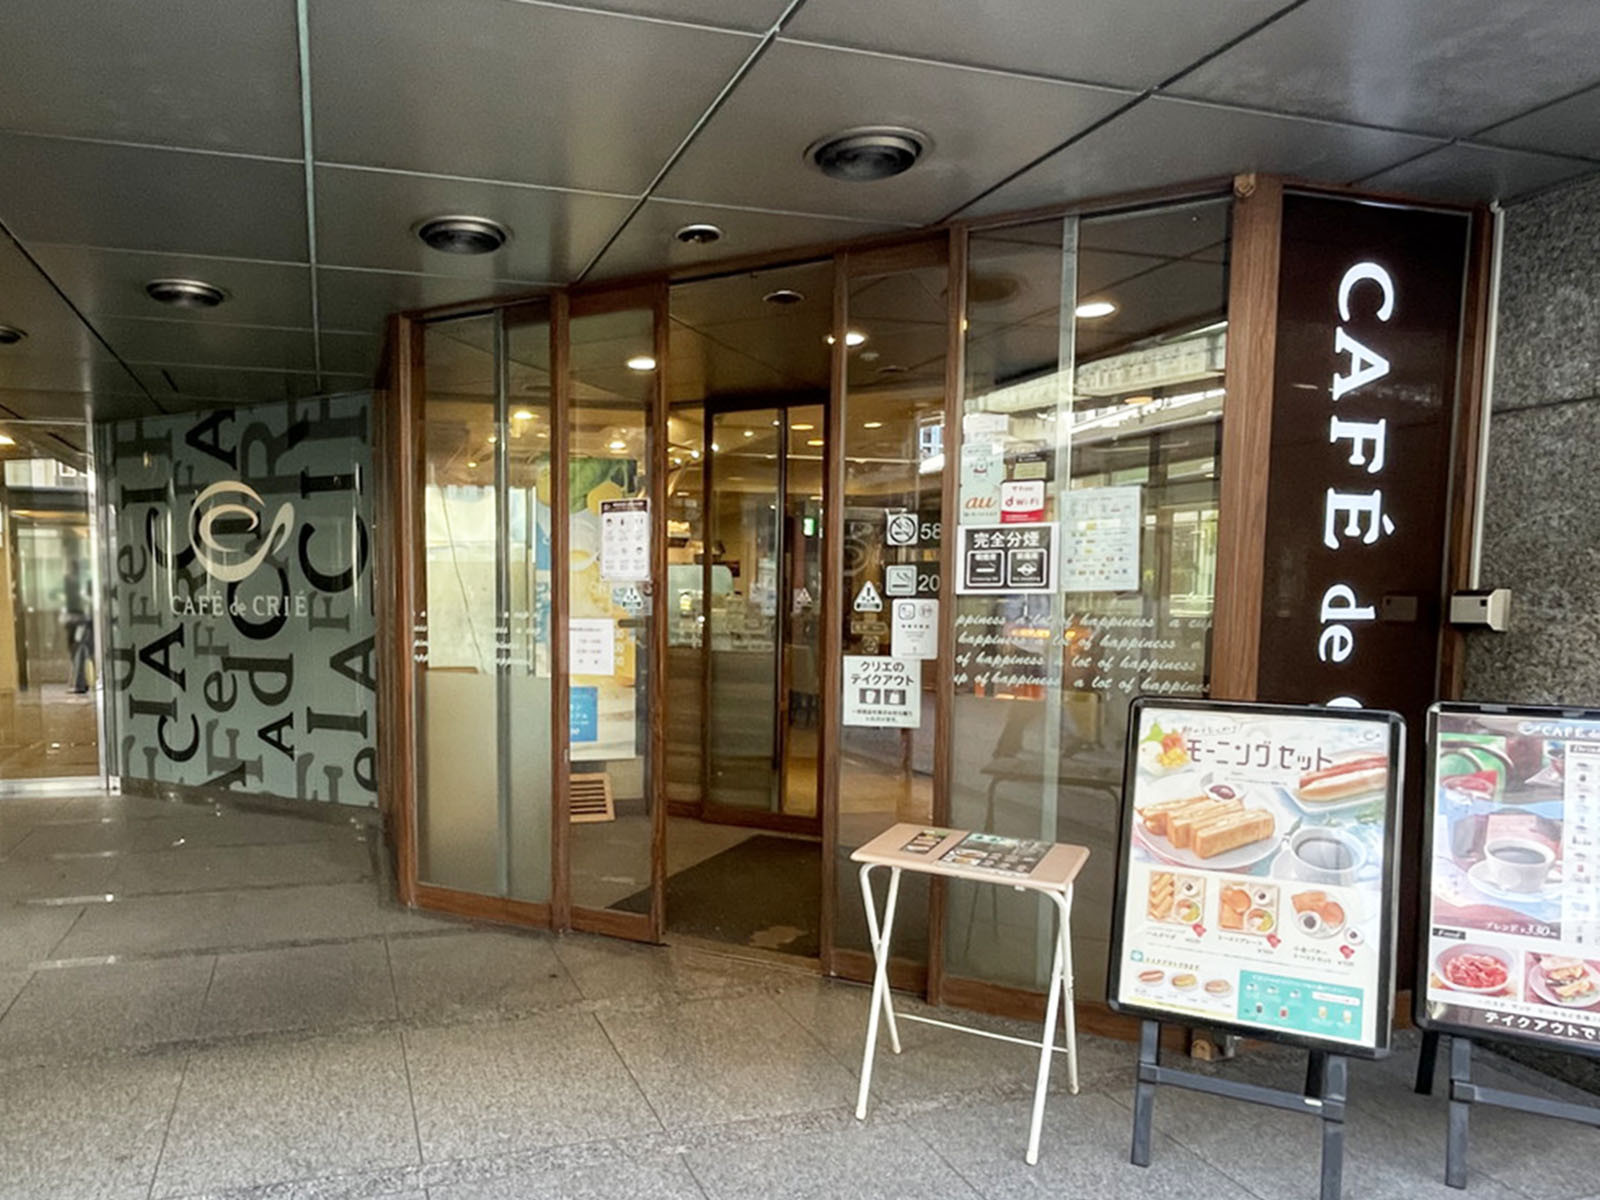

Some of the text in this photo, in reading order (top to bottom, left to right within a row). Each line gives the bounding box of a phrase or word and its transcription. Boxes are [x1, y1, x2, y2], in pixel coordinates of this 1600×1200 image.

[1323, 262, 1396, 551] CAFÉ
[965, 496, 998, 511] au
[920, 522, 941, 540] 58
[973, 530, 1041, 549] 完全分煙
[917, 574, 941, 592] 20
[171, 590, 224, 617] CAFÉ
[252, 590, 308, 617] CRIÉ
[1079, 612, 1155, 630] happiness
[1318, 583, 1376, 663] de
[1099, 633, 1176, 651] happiness
[860, 660, 905, 673] クリエの
[975, 651, 1045, 668] happiness
[1119, 655, 1197, 673] happiness
[850, 673, 915, 687] テイクアウト
[1186, 738, 1334, 772] モーニングセット
